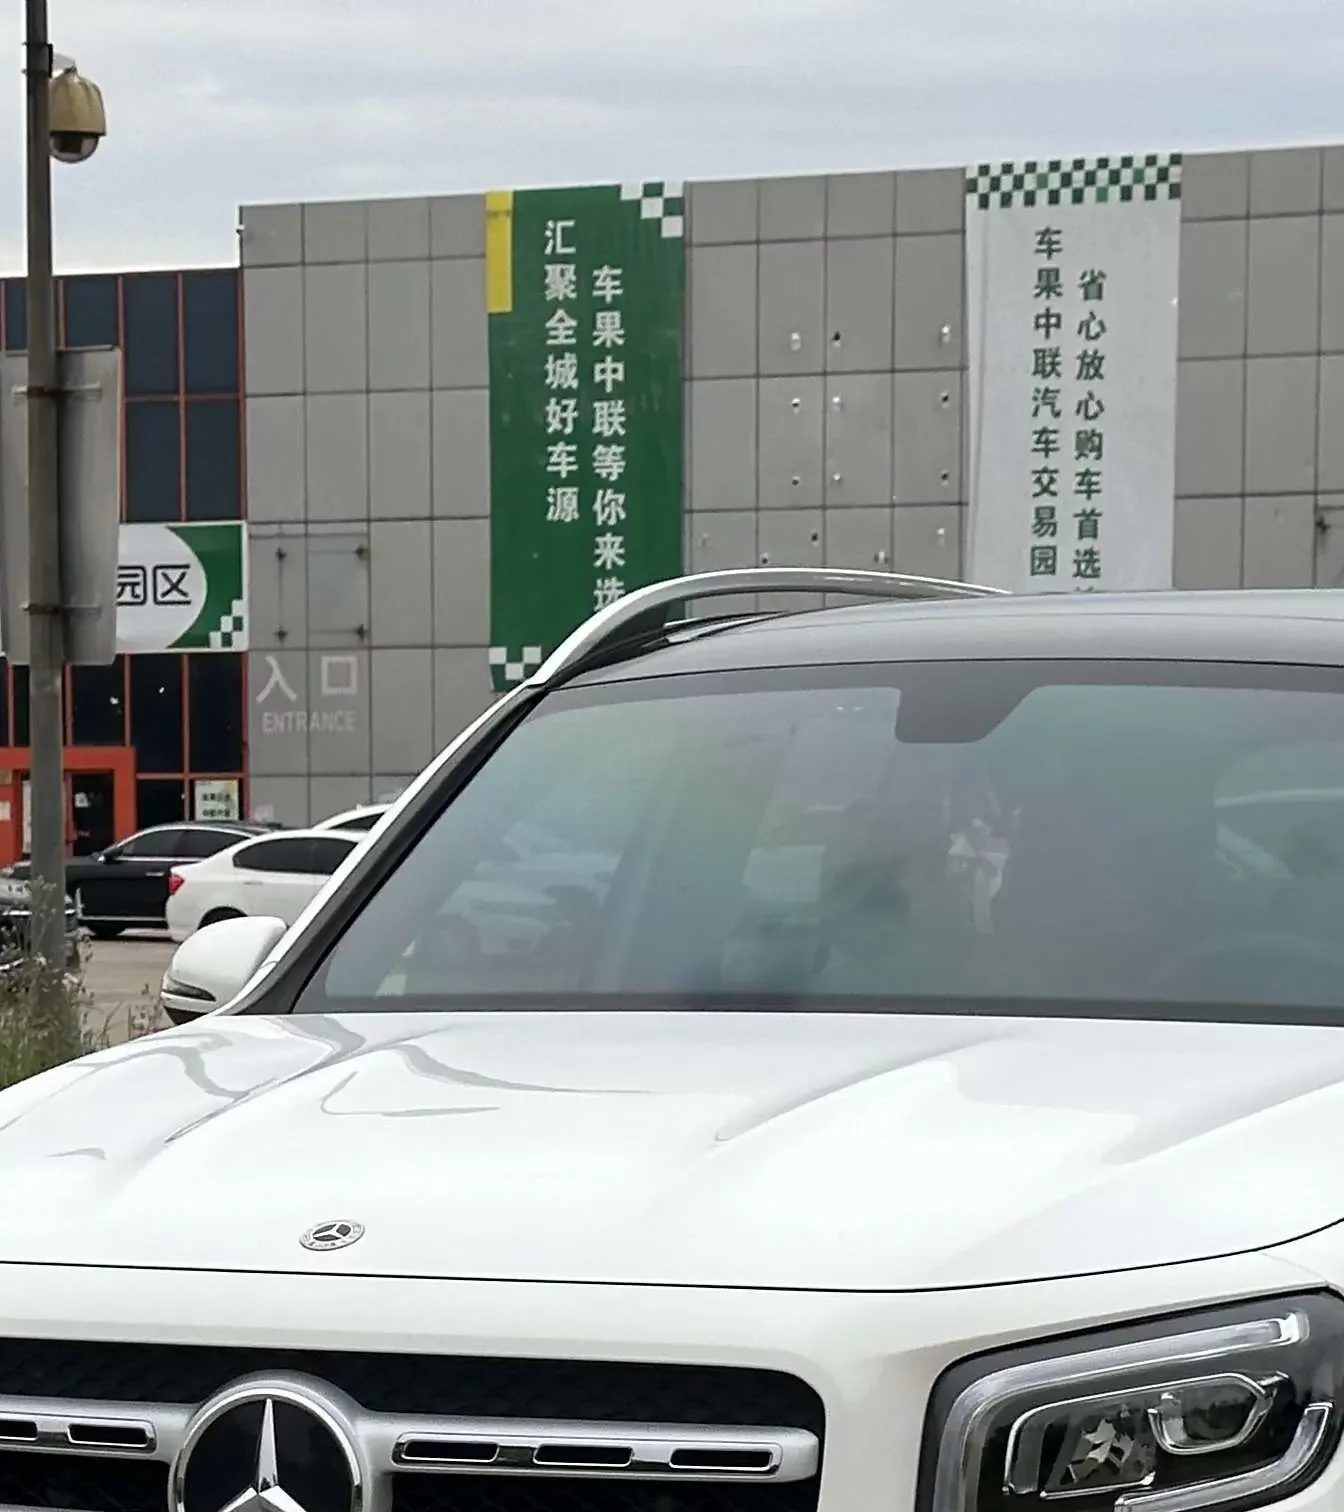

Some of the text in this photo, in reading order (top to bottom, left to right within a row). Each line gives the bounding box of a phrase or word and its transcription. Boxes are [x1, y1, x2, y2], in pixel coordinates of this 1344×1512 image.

[544, 219, 579, 522] 汇聚全城好车源
[592, 264, 626, 612] 车果中联等你来选
[1030, 226, 1063, 576] 车果中联汽车交易园
[1072, 268, 1107, 592] 省心放心购车首选
[256, 655, 358, 703] 入口
[262, 710, 356, 734] ENTRANCE
